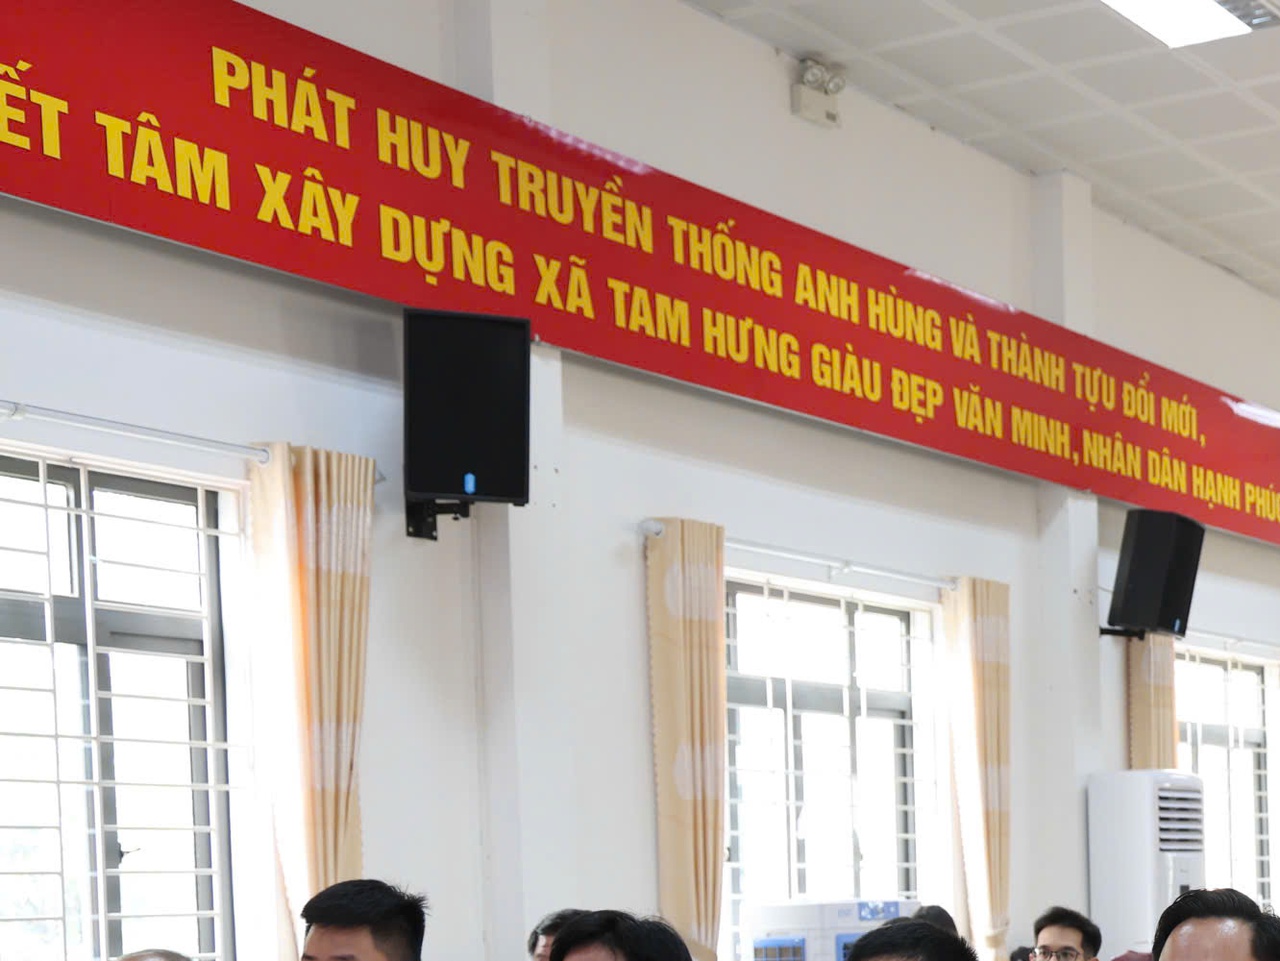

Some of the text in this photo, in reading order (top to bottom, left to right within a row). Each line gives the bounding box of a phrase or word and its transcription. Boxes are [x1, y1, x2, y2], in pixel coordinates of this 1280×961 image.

[94, 111, 231, 212] TÂM
[254, 163, 360, 247] XÂY
[379, 204, 516, 295] DỰNG
[533, 253, 595, 320] XÃ
[606, 277, 691, 348] TAM
[702, 307, 800, 379] HƯNG
[811, 342, 882, 402] GIÀU
[890, 367, 944, 424] ĐẸP
[953, 383, 1003, 439] VĂN
[1011, 407, 1079, 465] MINH,
[1082, 430, 1142, 480] NHÂN
[1148, 446, 1188, 494] DÂN
[1191, 465, 1242, 511] HẠNH
[211, 46, 1206, 447] PHÁT HUY TRUYỀN THỐNG ANH HÙNG VÀ THÀNH TỰU ĐỔI MỚI,
